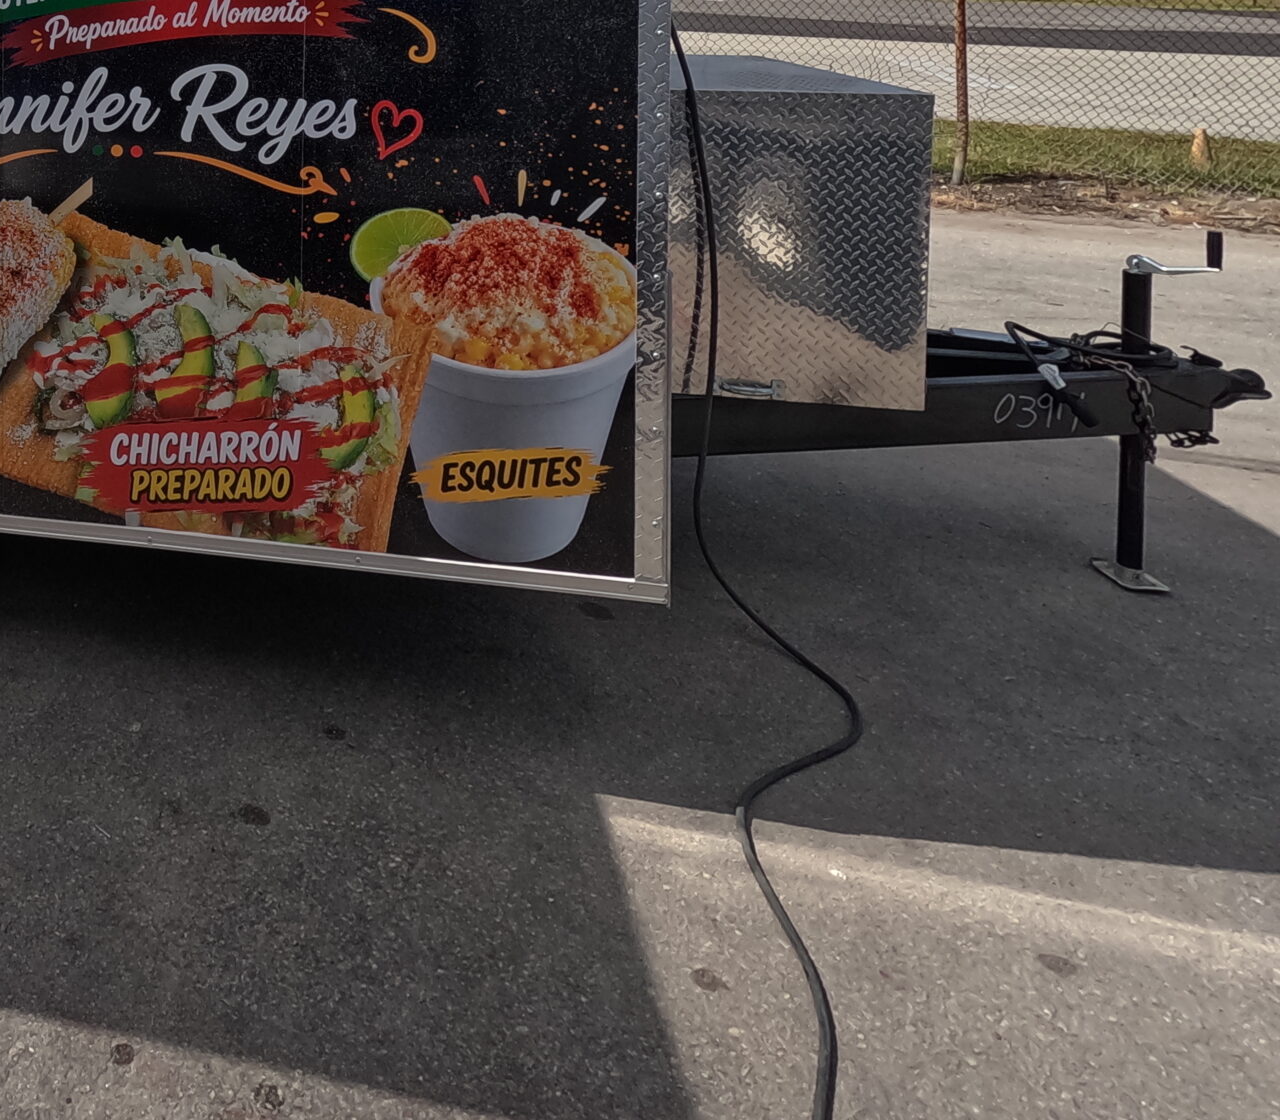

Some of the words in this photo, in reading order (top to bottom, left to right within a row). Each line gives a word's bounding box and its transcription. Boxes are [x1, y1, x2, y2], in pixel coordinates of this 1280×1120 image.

[43, 6, 168, 50] Preparado
[172, 1, 197, 29] al
[169, 63, 358, 165] Reyes
[109, 421, 302, 466] CHICHARRÓN
[131, 467, 291, 502] PREPARADO
[440, 455, 583, 494] ESQUITES
